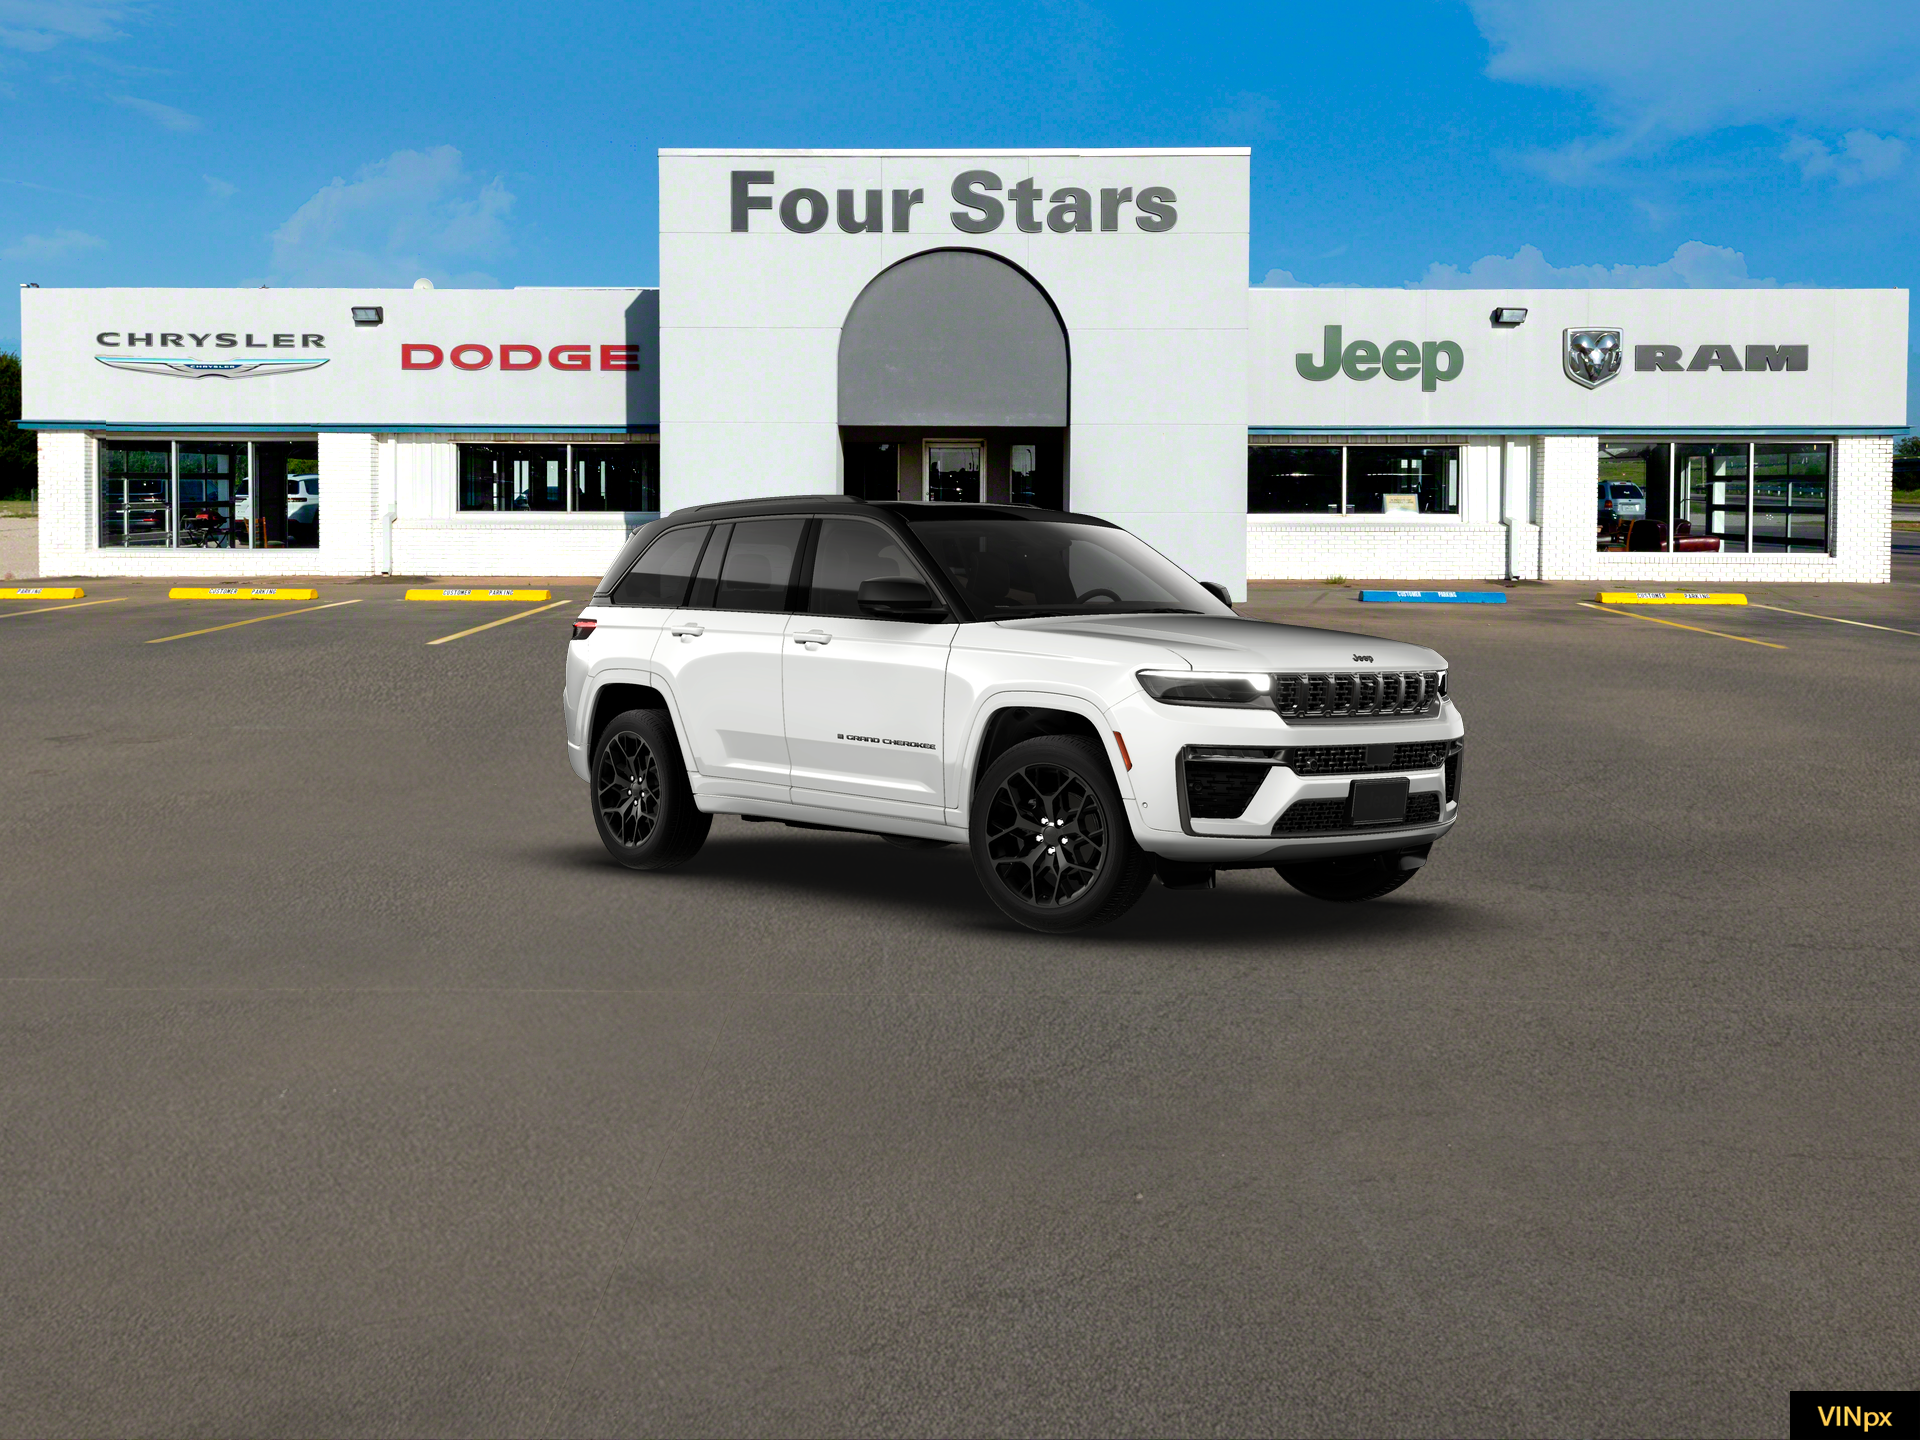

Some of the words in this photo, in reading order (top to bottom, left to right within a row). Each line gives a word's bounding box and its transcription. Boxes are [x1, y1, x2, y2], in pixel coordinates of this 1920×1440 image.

[730, 170, 924, 233] Four
[949, 169, 1178, 233] Stars
[96, 331, 326, 348] CHRYSLER
[401, 343, 641, 371] DODGE
[1296, 324, 1465, 392] Jeep
[1634, 344, 1809, 372] RAM
[1352, 653, 1374, 663] Jeep
[846, 734, 880, 743] GRAND
[882, 738, 937, 750] CHEROKEE
